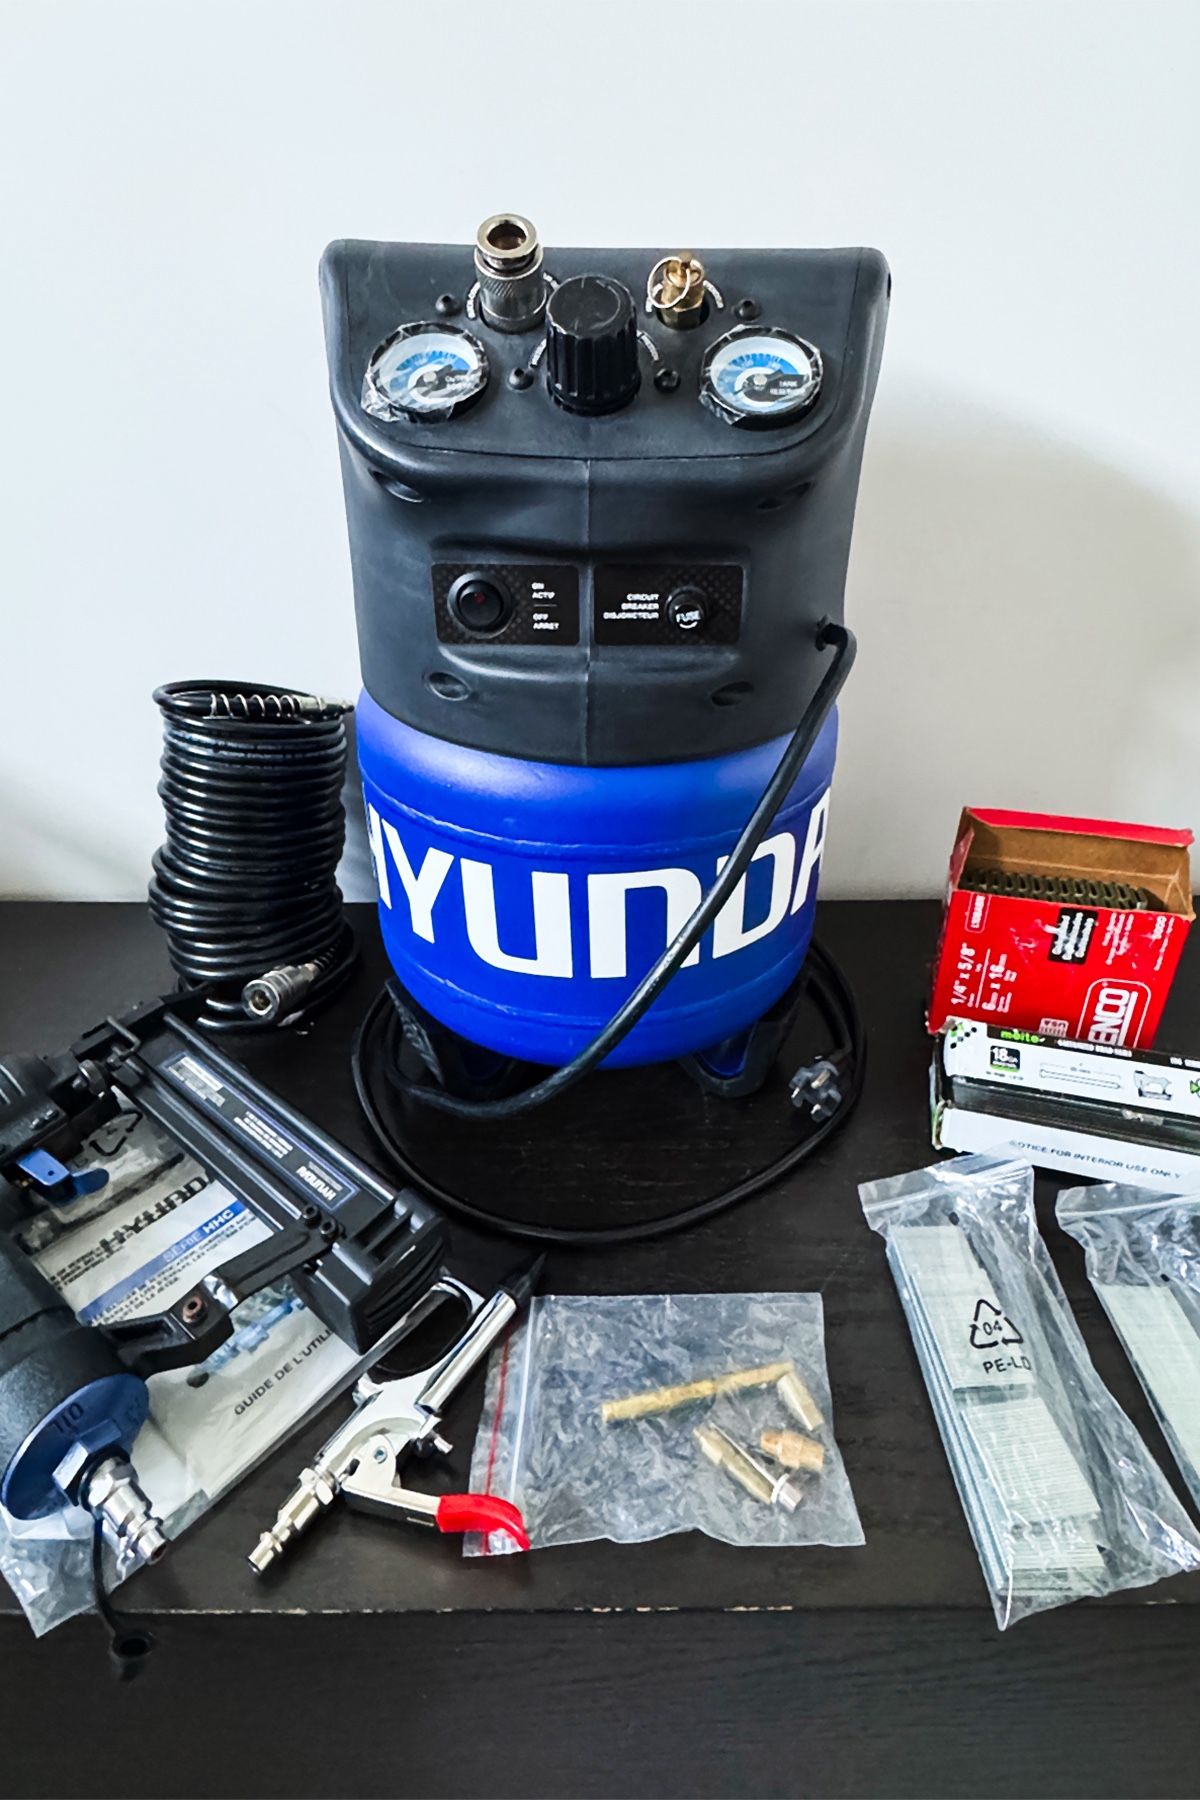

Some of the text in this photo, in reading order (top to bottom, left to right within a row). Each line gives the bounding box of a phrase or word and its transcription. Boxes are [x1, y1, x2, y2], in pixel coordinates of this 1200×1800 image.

[626, 593, 659, 601] CIRCUIT
[621, 602, 659, 610] BREAKER
[533, 613, 549, 621] OFF
[603, 611, 659, 619] DISJONCTEUR
[676, 610, 700, 623] FUSE
[1088, 987, 1131, 1047] ENCO
[1010, 1140, 1047, 1153] OTICE
[1050, 1149, 1072, 1159] FOR
[1073, 1153, 1124, 1168] INTERIOR
[1126, 1163, 1148, 1174] USE
[234, 1325, 334, 1416] GUIDE DE L'UTILI
[982, 1356, 1032, 1374] PE-LD
